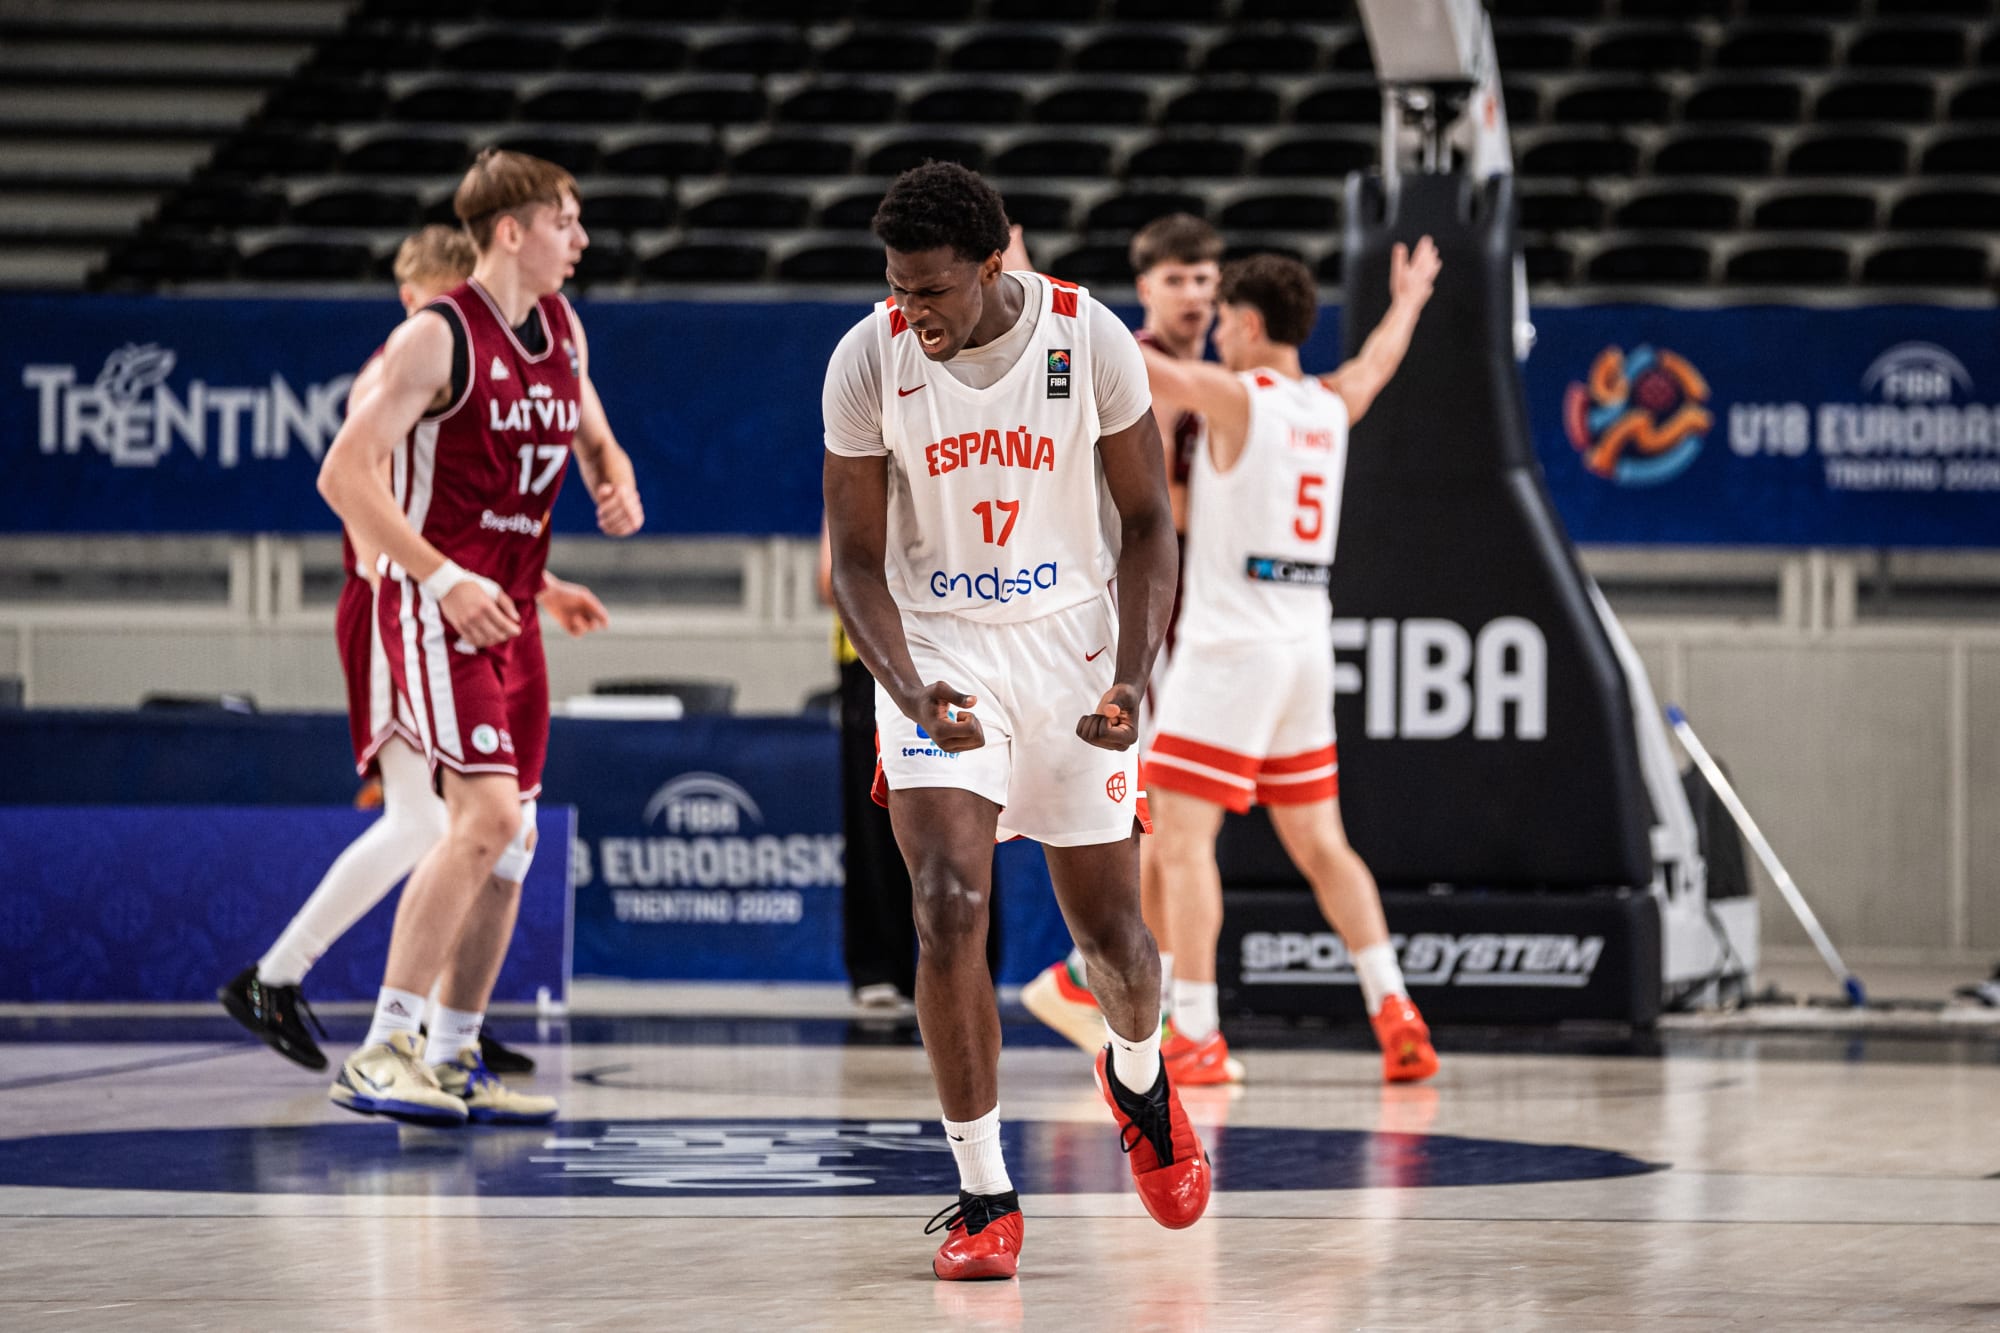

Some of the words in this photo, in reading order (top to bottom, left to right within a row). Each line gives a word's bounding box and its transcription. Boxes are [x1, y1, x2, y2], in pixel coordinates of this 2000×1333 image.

[1050, 377, 1067, 387] FIBA
[925, 425, 1055, 477] ESPAÑA
[1729, 403, 1810, 455] U18
[517, 443, 569, 495] 17
[972, 499, 1020, 547] 17
[1294, 475, 1325, 542] 5
[930, 561, 1057, 603] endesa
[666, 803, 740, 832] FIBA
[613, 891, 733, 922] TRENTINO
